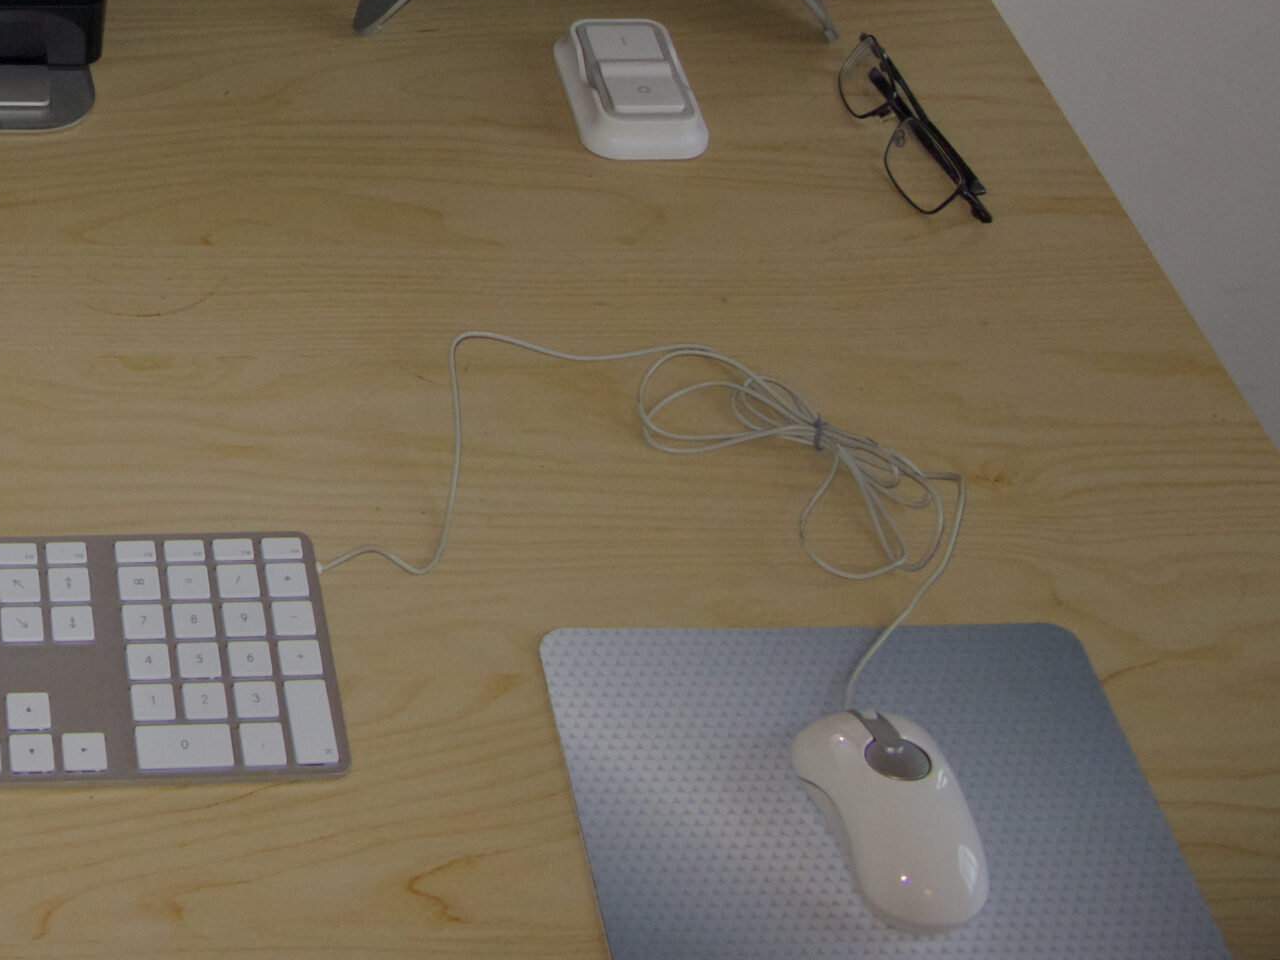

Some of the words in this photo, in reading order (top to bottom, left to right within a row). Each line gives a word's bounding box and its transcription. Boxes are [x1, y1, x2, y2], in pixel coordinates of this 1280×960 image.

[140, 615, 148, 625] 7
[190, 614, 198, 625] 8
[239, 612, 248, 623] 9
[144, 655, 153, 665] 4
[195, 653, 204, 664] 5
[246, 653, 255, 663] 6
[200, 693, 209, 705] 2
[252, 692, 261, 704] 3
